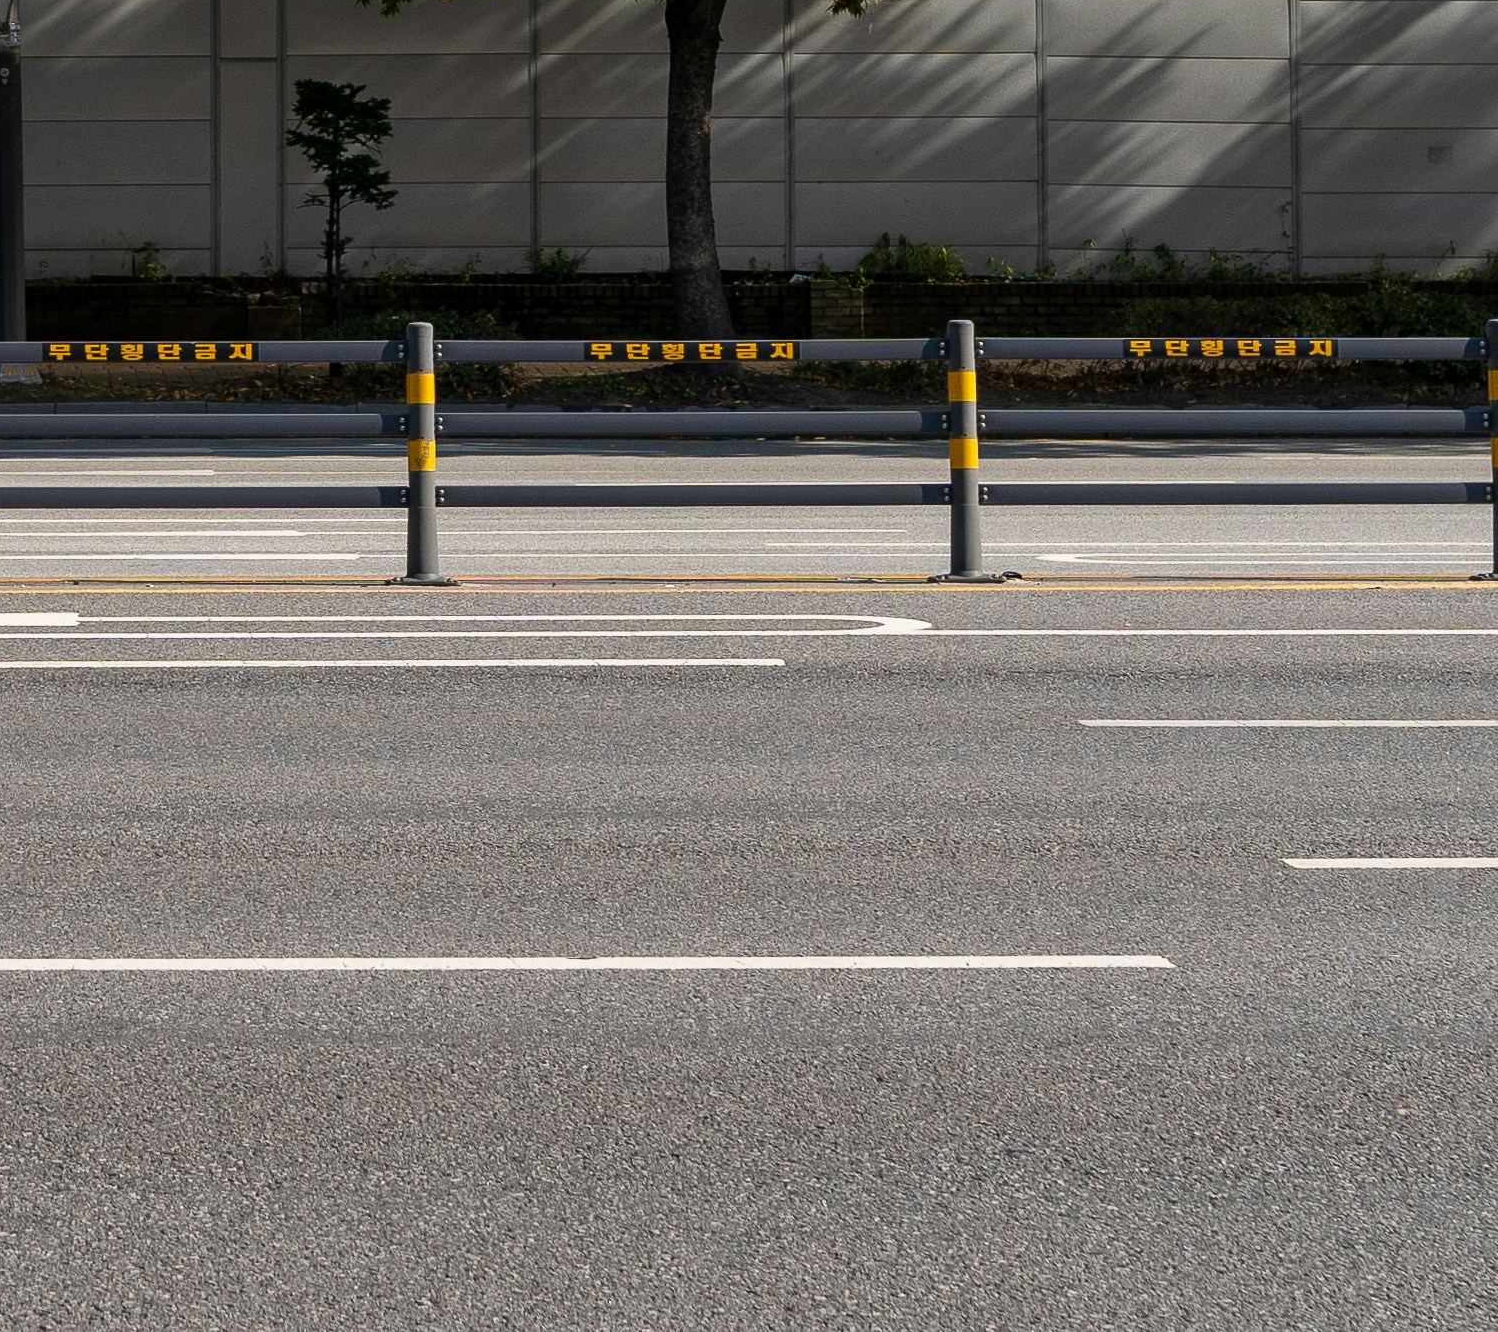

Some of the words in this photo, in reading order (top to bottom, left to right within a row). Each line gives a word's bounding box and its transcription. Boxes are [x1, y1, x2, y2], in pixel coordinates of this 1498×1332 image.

[48, 343, 253, 360] 무단횡단금지
[590, 342, 794, 359] 무단횡단금지
[1128, 339, 1332, 356] 무단횡단금지
